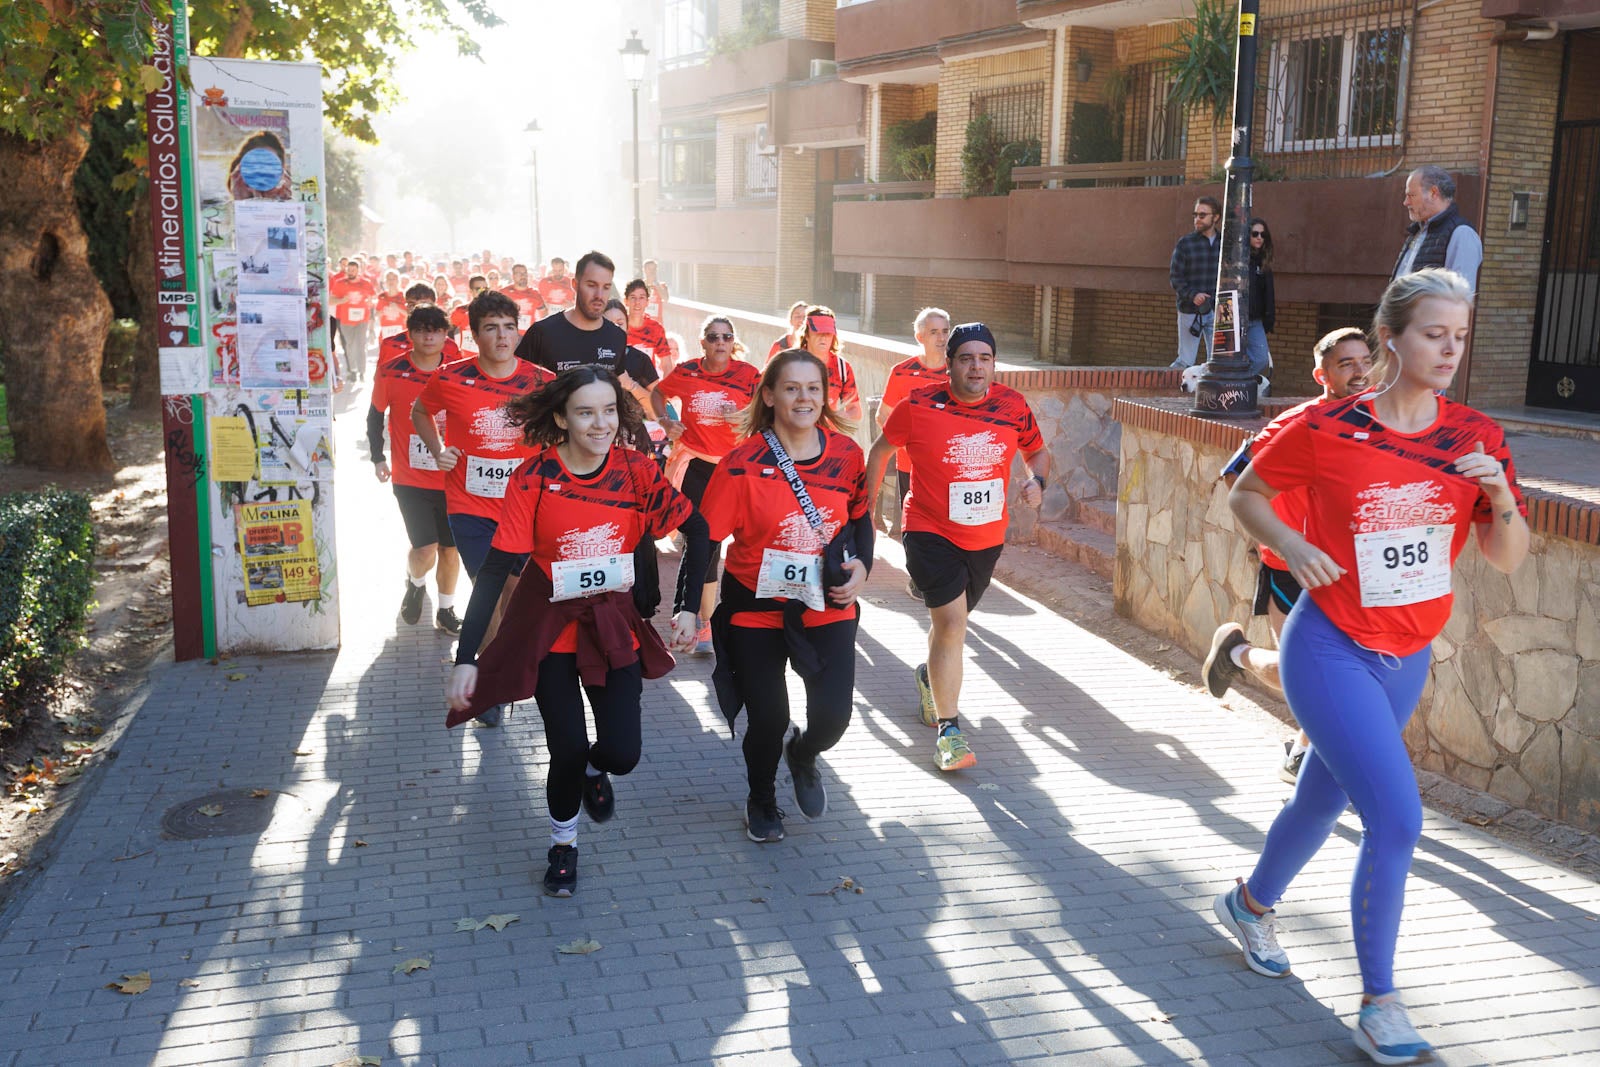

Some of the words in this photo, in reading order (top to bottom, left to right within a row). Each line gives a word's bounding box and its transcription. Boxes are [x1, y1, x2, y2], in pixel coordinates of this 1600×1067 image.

[152, 16, 174, 146] Saluable
[154, 152, 181, 269] Itinerarios
[161, 294, 195, 303] MPS
[950, 445, 1002, 456] carrera
[476, 466, 513, 480] 1494
[963, 490, 991, 505] 881
[1360, 503, 1448, 521] carrera
[282, 522, 305, 546] B
[560, 542, 622, 556] carrera
[1383, 541, 1429, 569] 958
[283, 567, 304, 580] 149
[308, 565, 317, 577] €
[580, 570, 606, 588] 59
[784, 564, 808, 582] 61
